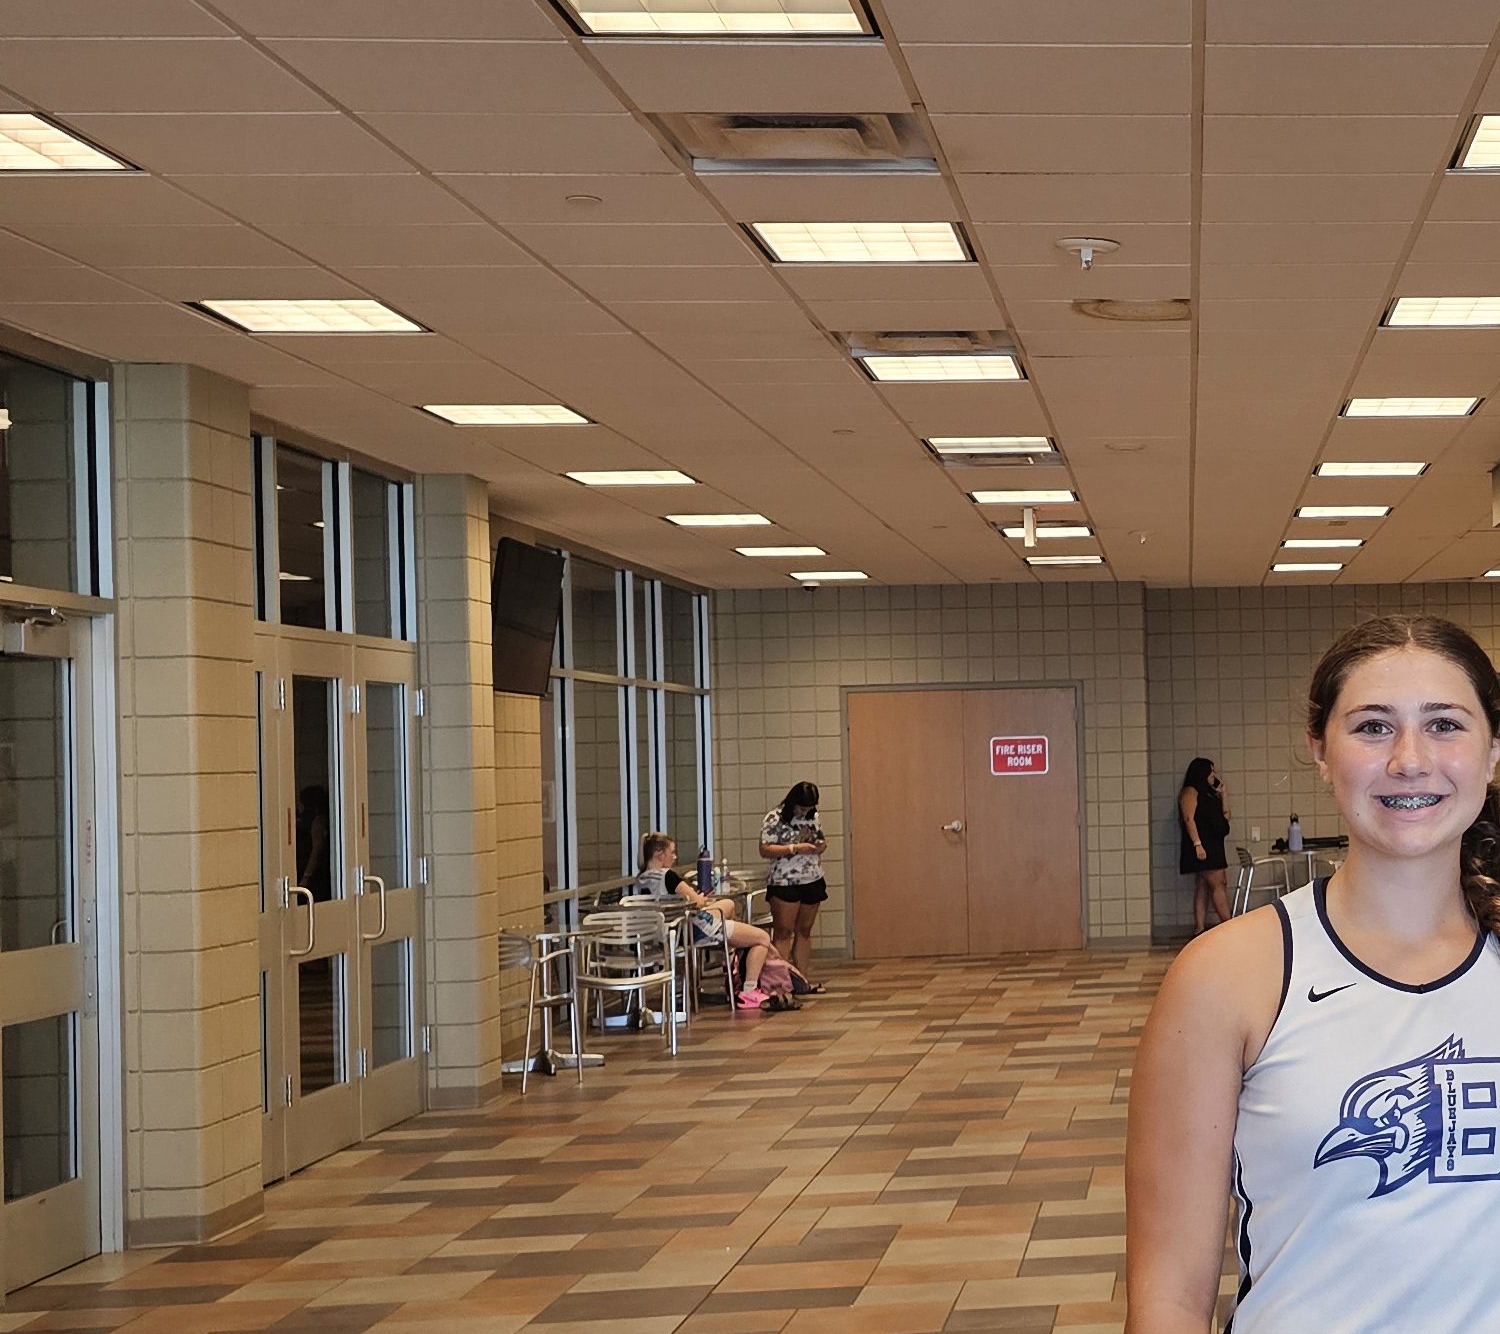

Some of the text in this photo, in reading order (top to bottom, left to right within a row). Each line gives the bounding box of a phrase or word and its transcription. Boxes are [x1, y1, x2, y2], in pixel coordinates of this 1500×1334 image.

[995, 743, 1043, 756] FIRE RISER
[1007, 755, 1032, 767] ROOM
[1445, 1069, 1458, 1172] BLUEJAYS
